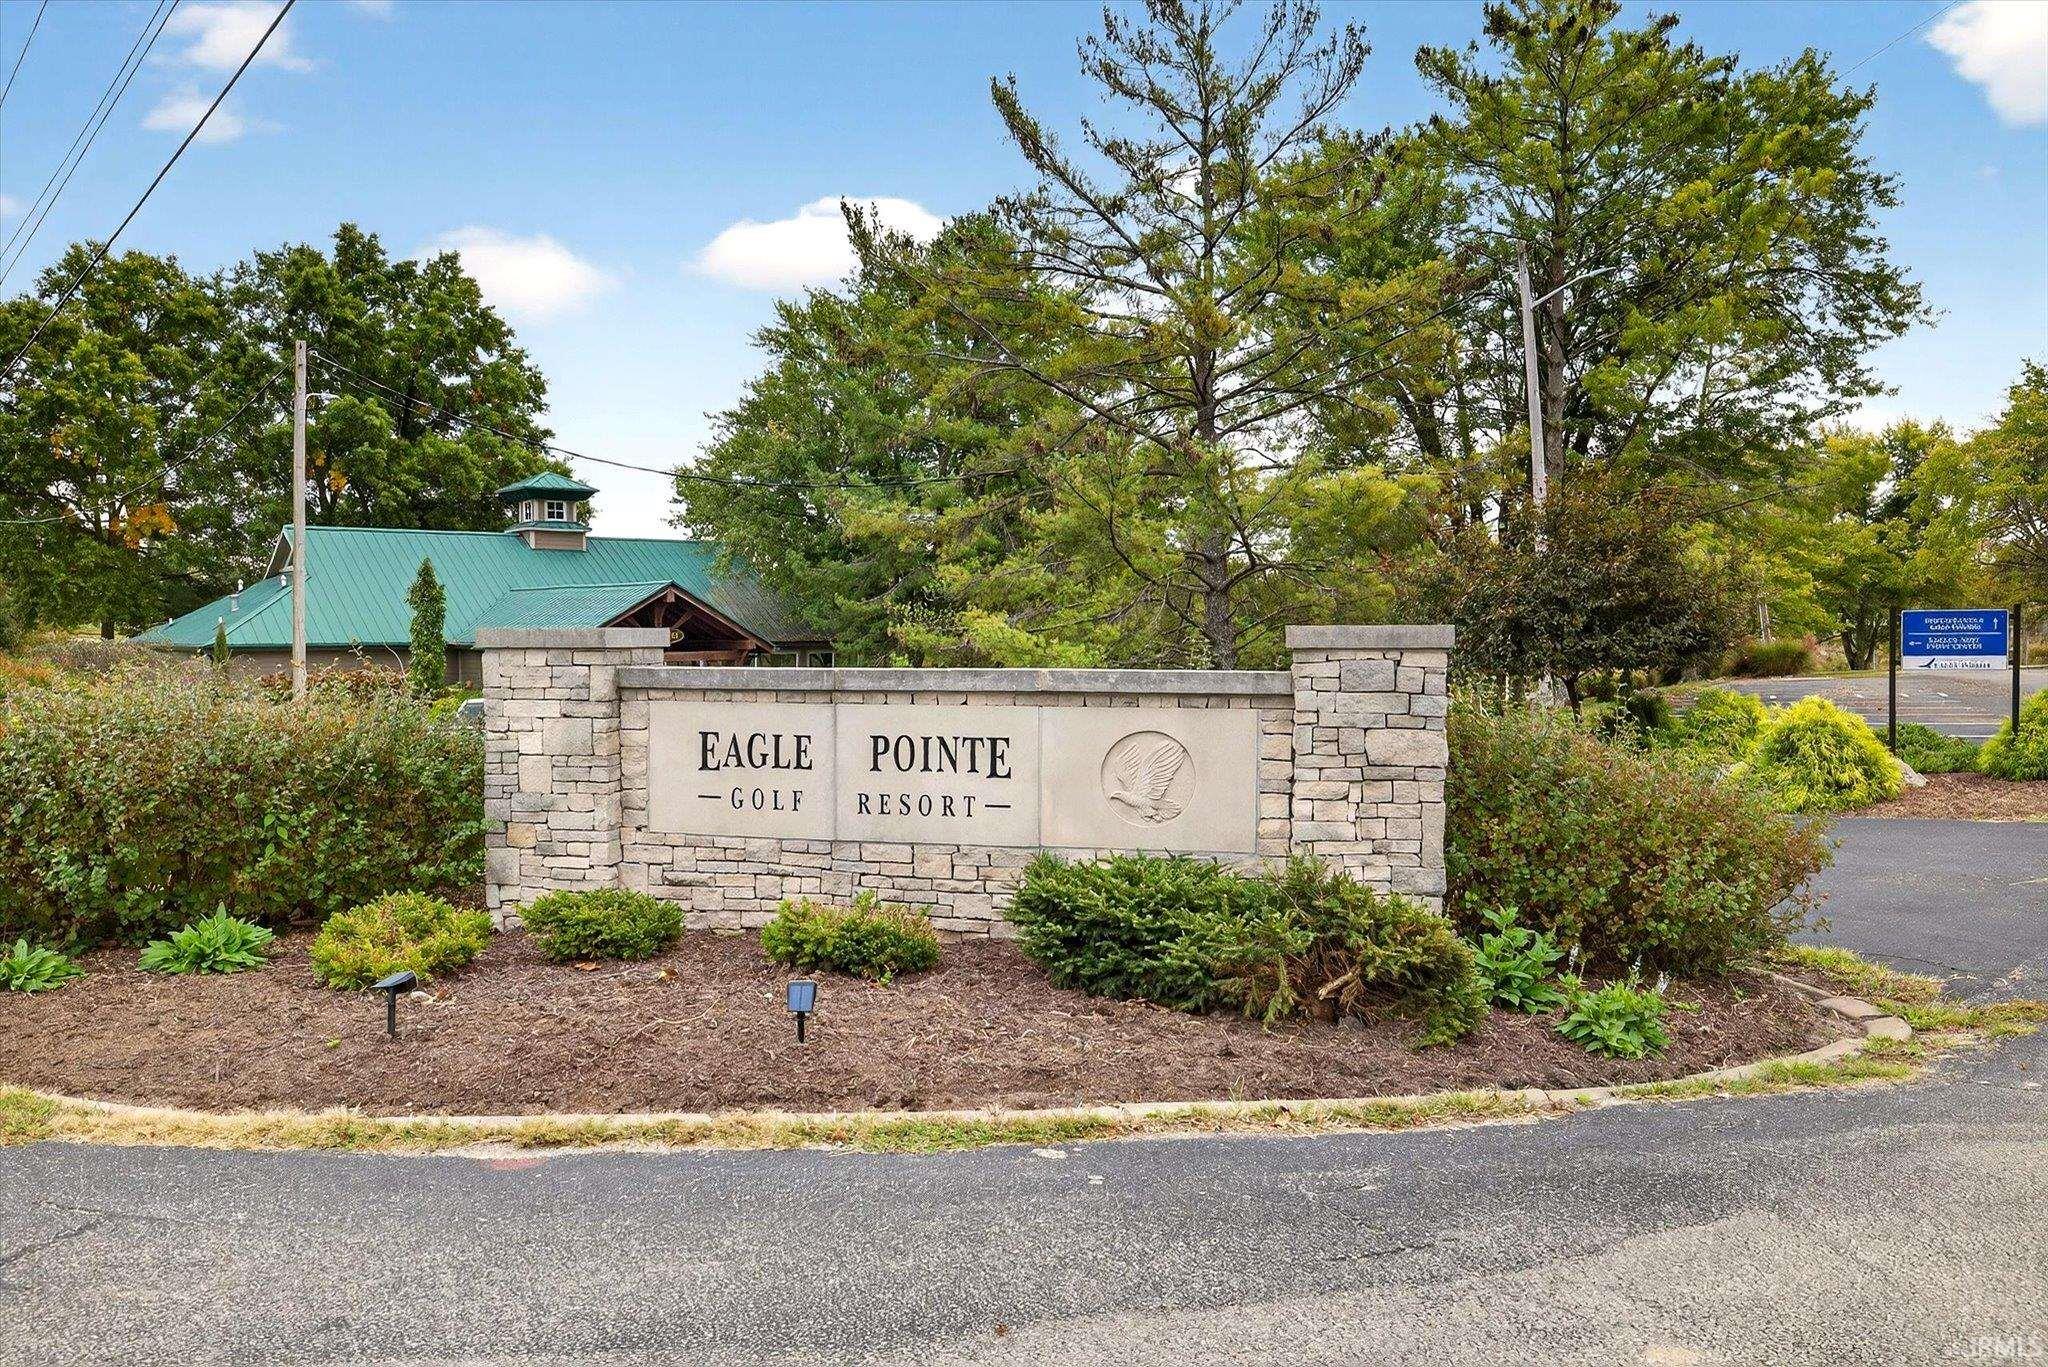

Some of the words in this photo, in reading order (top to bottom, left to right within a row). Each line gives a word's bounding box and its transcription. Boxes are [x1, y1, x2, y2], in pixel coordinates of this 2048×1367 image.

[697, 731, 813, 771] EAGLE
[869, 734, 1012, 779] POINTE
[731, 786, 803, 812] GOLF
[857, 792, 976, 818] RESORT
